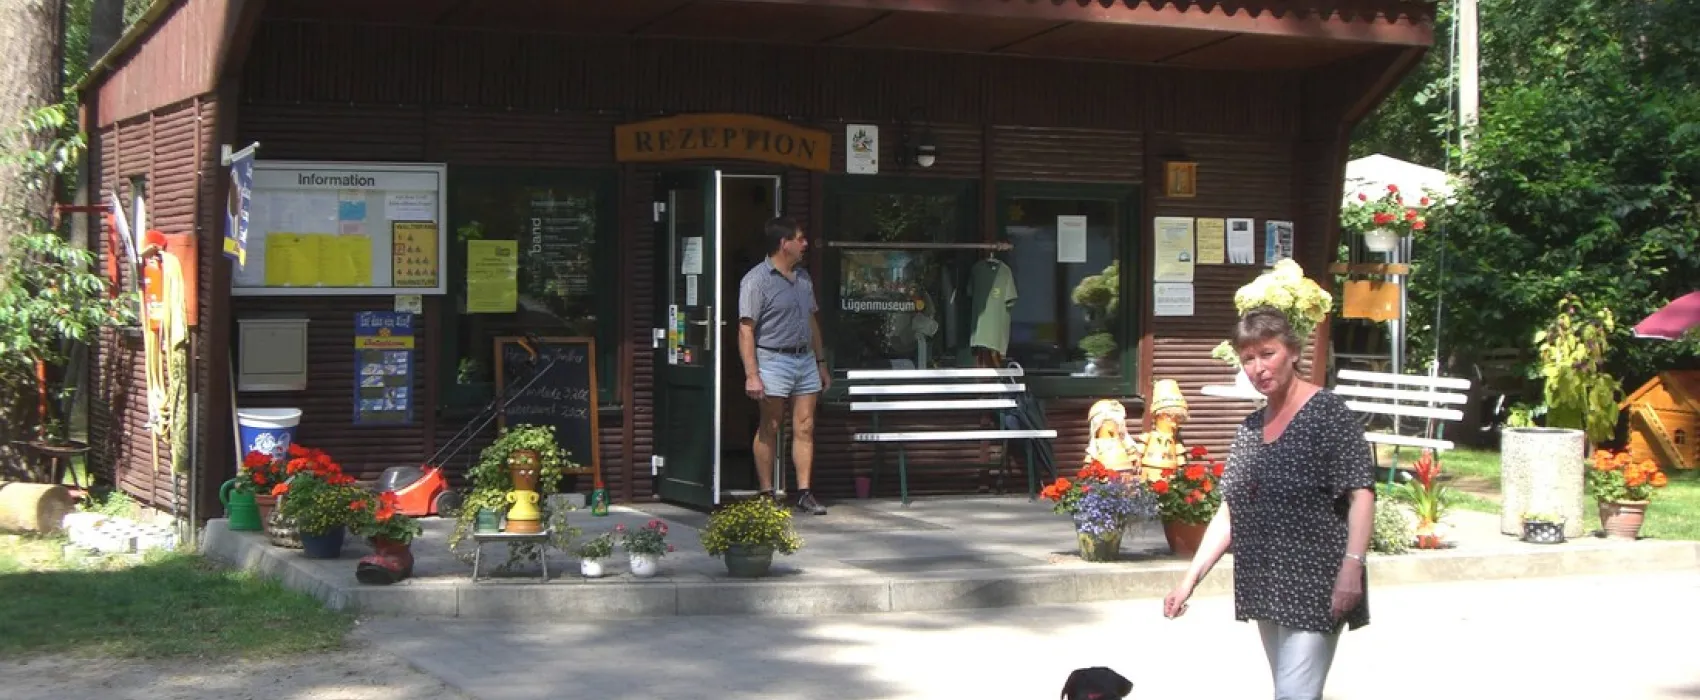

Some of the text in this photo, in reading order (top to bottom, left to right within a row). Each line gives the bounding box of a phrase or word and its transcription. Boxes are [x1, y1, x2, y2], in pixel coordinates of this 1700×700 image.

[634, 127, 817, 159] REZEPTION
[298, 173, 375, 187] Information
[530, 218, 542, 253] band
[841, 298, 915, 312] Lügenmuseum
